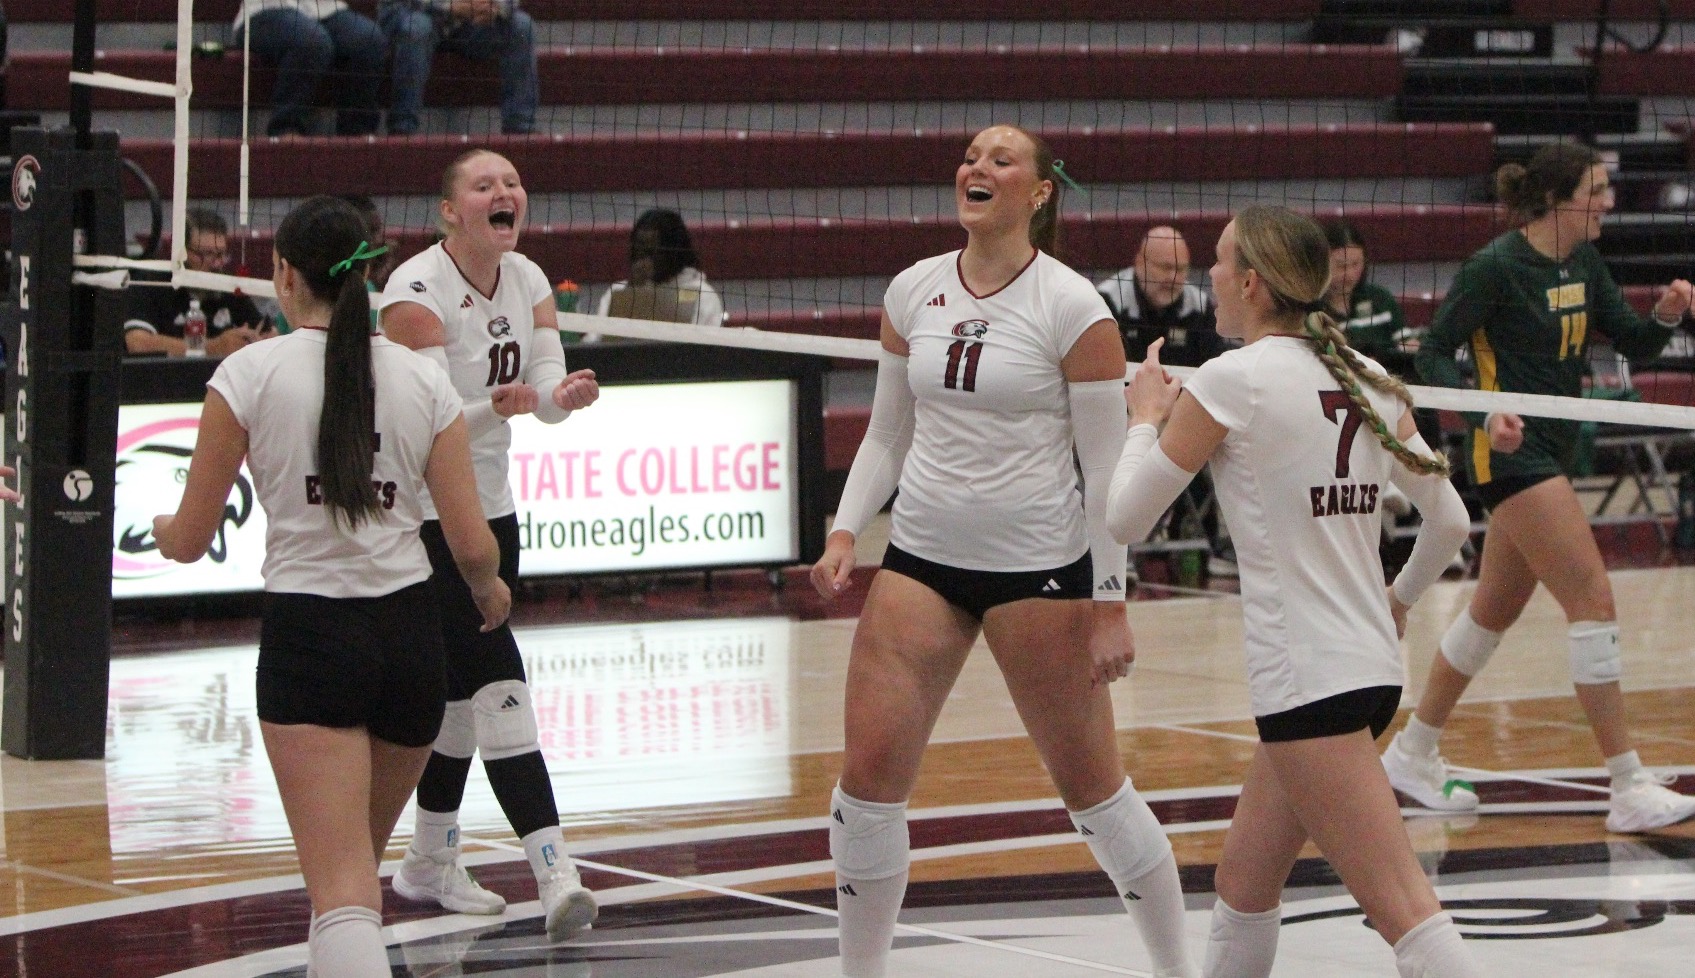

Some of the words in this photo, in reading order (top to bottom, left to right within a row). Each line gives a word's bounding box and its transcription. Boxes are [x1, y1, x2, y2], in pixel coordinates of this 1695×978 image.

[1559, 311, 1587, 361] 14
[486, 341, 520, 387] 10
[944, 339, 984, 392] 11
[13, 255, 30, 643] EAGLES
[1318, 390, 1363, 478] 7
[616, 442, 781, 496] COLLEGE
[1310, 483, 1379, 517] EAGLES
